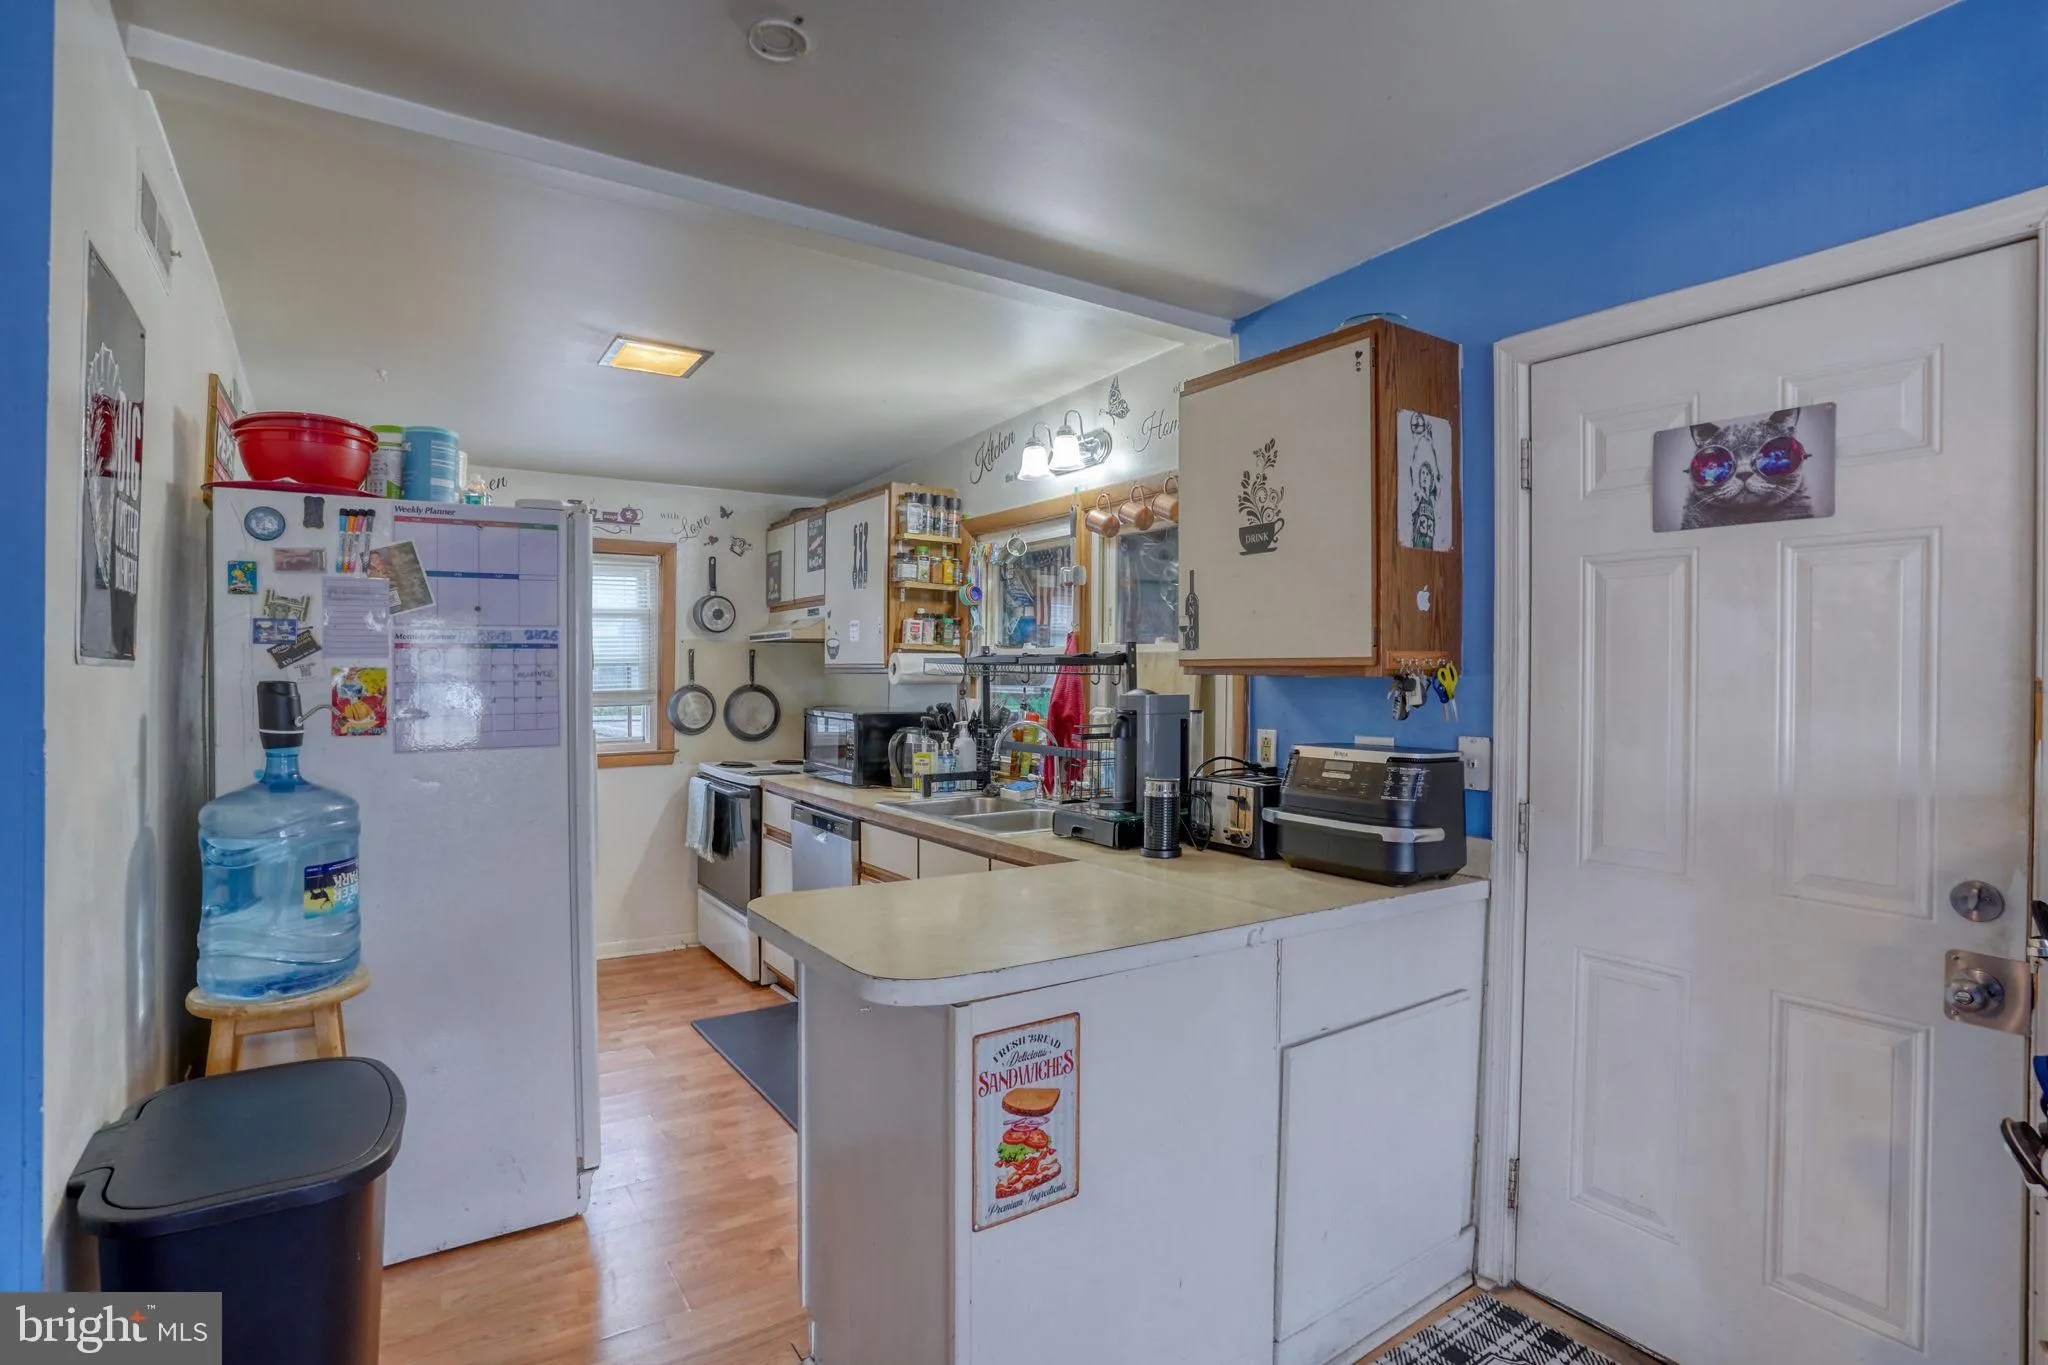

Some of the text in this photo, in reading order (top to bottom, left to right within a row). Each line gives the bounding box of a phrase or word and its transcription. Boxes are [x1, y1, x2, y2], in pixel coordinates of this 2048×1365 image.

[116, 389, 142, 501] BIG
[1133, 409, 1180, 453] Hom
[970, 430, 1016, 484] Kitchen
[394, 504, 456, 516] Weekly Planner
[660, 511, 679, 520] with
[672, 515, 711, 543] Love
[1245, 531, 1269, 544] DRINK
[992, 1033, 1062, 1064] FRESH BREAD
[1007, 1049, 1048, 1067] Delicious
[978, 1049, 1074, 1098] SANDWICHES
[985, 1182, 1067, 1219] Premium Ingredients
